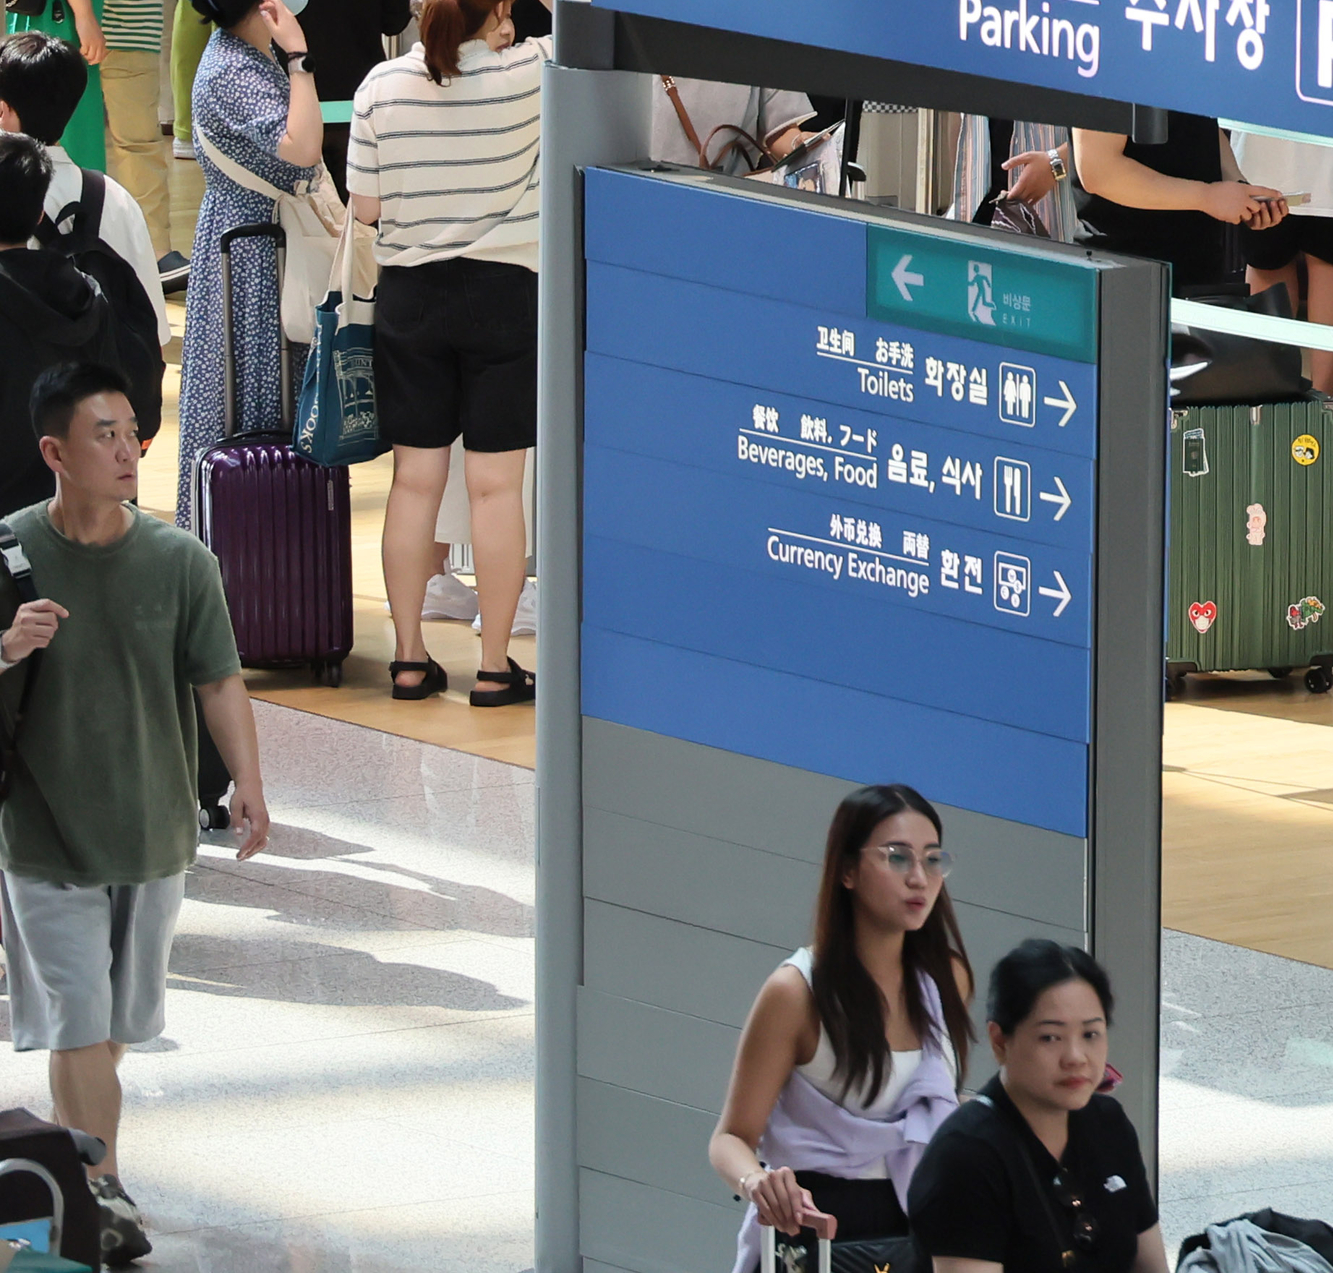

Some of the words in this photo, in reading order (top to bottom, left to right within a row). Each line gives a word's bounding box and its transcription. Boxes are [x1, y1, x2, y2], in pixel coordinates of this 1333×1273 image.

[1002, 293, 1032, 312] 비상문
[817, 325, 855, 356] 卫生间
[875, 337, 914, 369] お手洗
[857, 367, 914, 403] Toilets
[924, 356, 988, 406] 화장실
[753, 404, 779, 433] 餐饮
[737, 434, 828, 482] Beverages,
[834, 459, 878, 490] Food
[887, 443, 936, 494] 음료,
[941, 455, 983, 500] 식사
[830, 513, 882, 549] 外币兑换
[902, 530, 929, 559] 両替
[767, 535, 844, 579] Currency
[847, 551, 929, 598] Exchange
[940, 548, 983, 595] 환전
